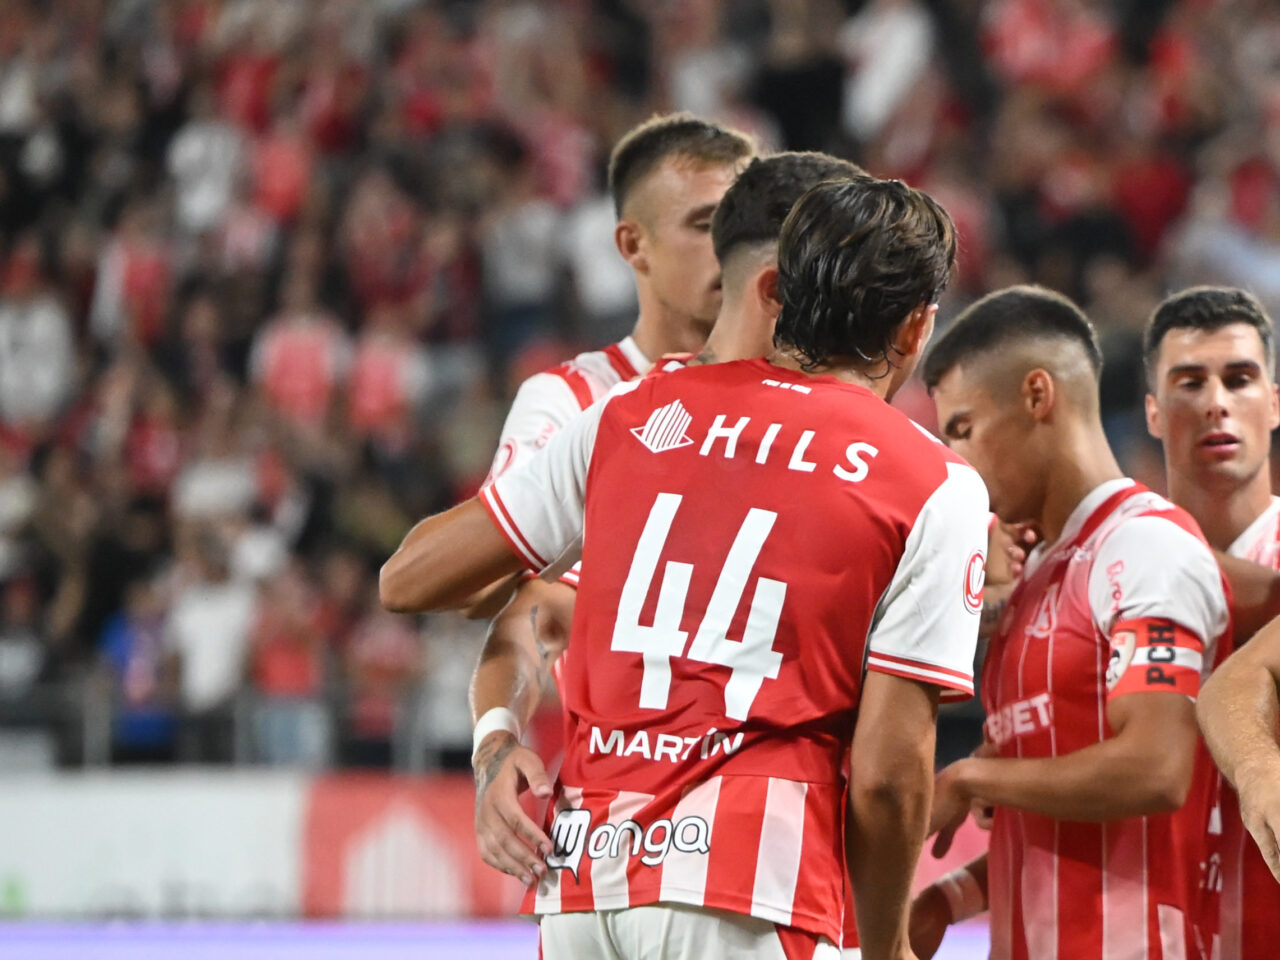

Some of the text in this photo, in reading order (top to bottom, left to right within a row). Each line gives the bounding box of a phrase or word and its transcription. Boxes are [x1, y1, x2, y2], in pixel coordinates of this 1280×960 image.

[699, 414, 879, 482] HILS
[610, 492, 788, 722] 44
[1147, 624, 1175, 686] PCH
